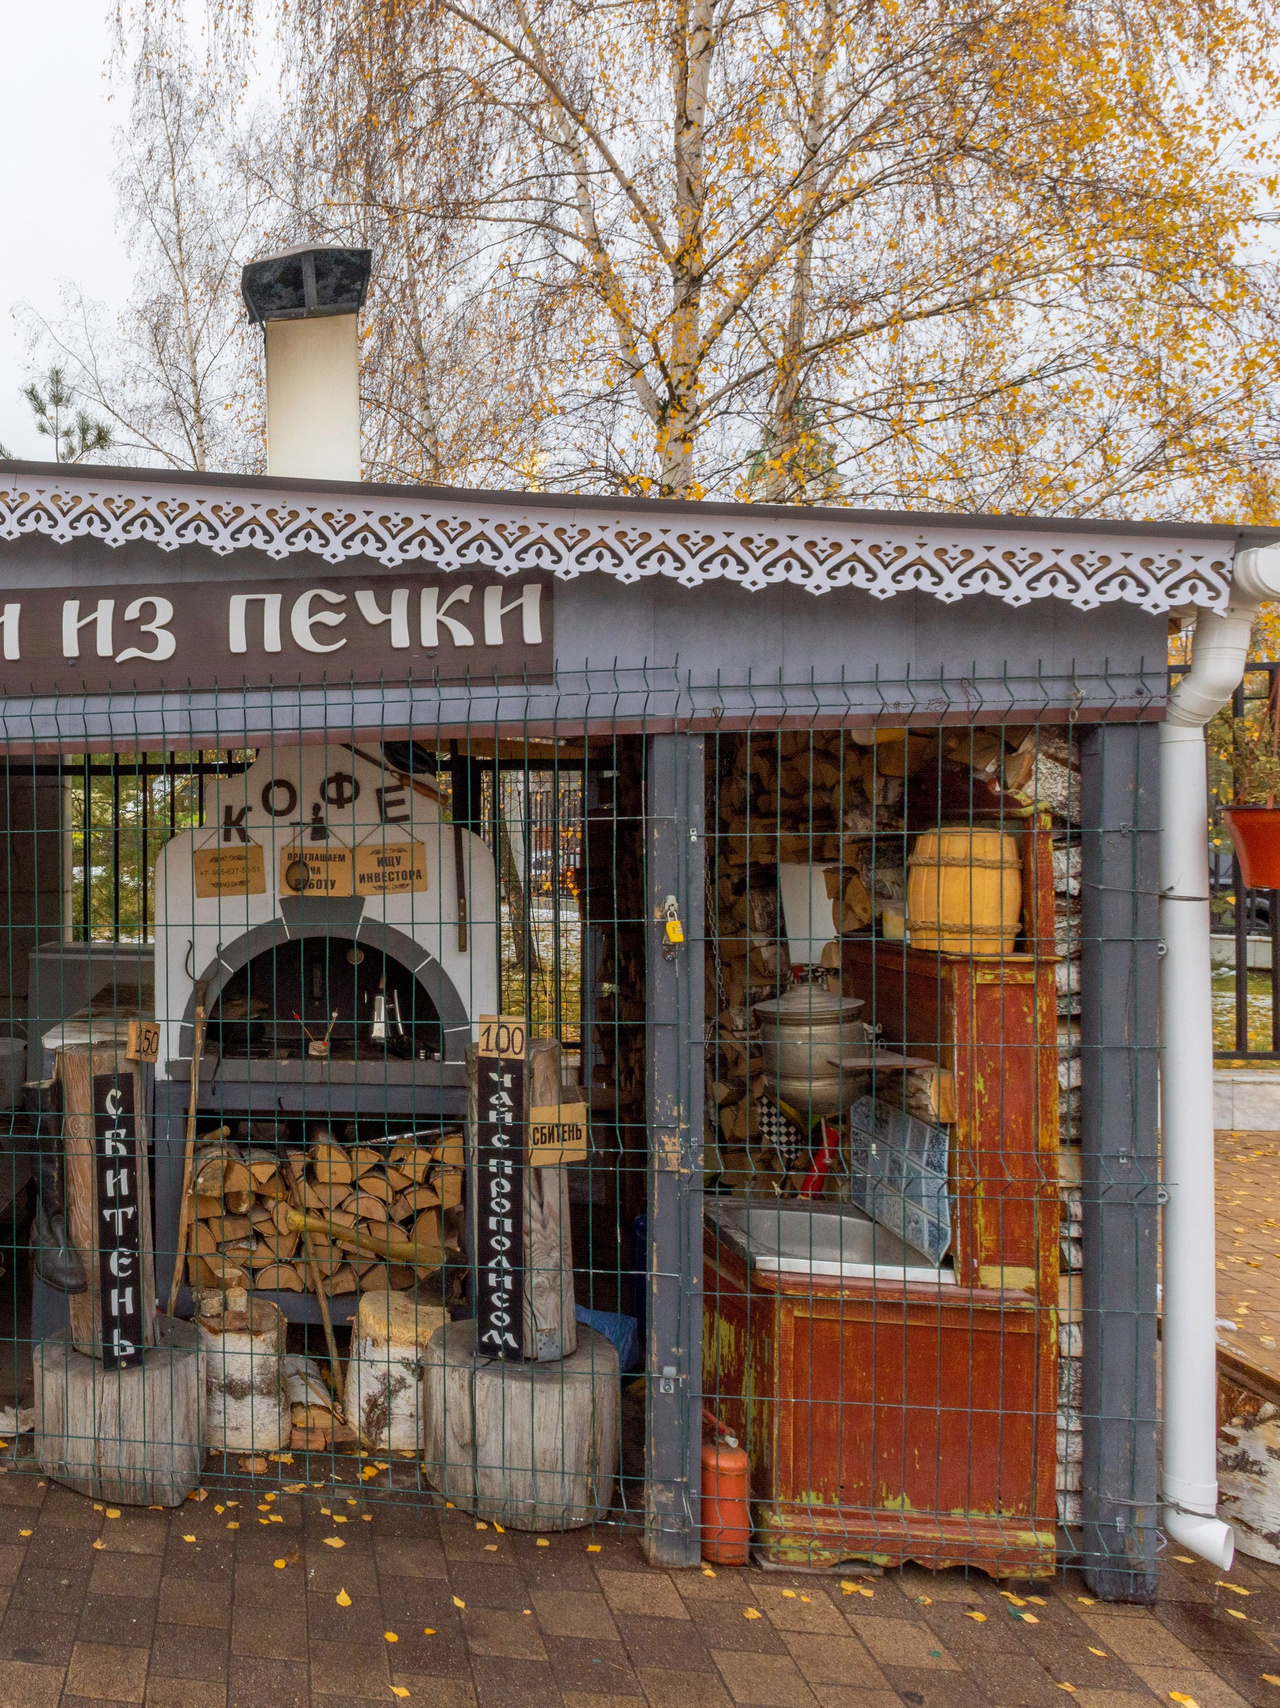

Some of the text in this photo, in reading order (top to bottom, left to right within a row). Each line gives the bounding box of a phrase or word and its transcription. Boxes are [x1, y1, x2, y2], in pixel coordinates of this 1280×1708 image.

[61, 595, 177, 664] ИЗ
[228, 583, 543, 654] ПЕЧКИ
[223, 771, 410, 843] КОФЕ
[287, 852, 346, 862] ПРИГЛАШАЕМ
[377, 855, 401, 868] ИЩУ
[359, 869, 422, 884] ИНВЕСТОРА
[481, 1024, 524, 1055] 100
[532, 1122, 583, 1146] СБИТЕНЬ
[103, 1087, 135, 1357] СБИТЕНЬ
[482, 1072, 519, 1349] ЧАЙ С ПРОПОЛИСОМ
